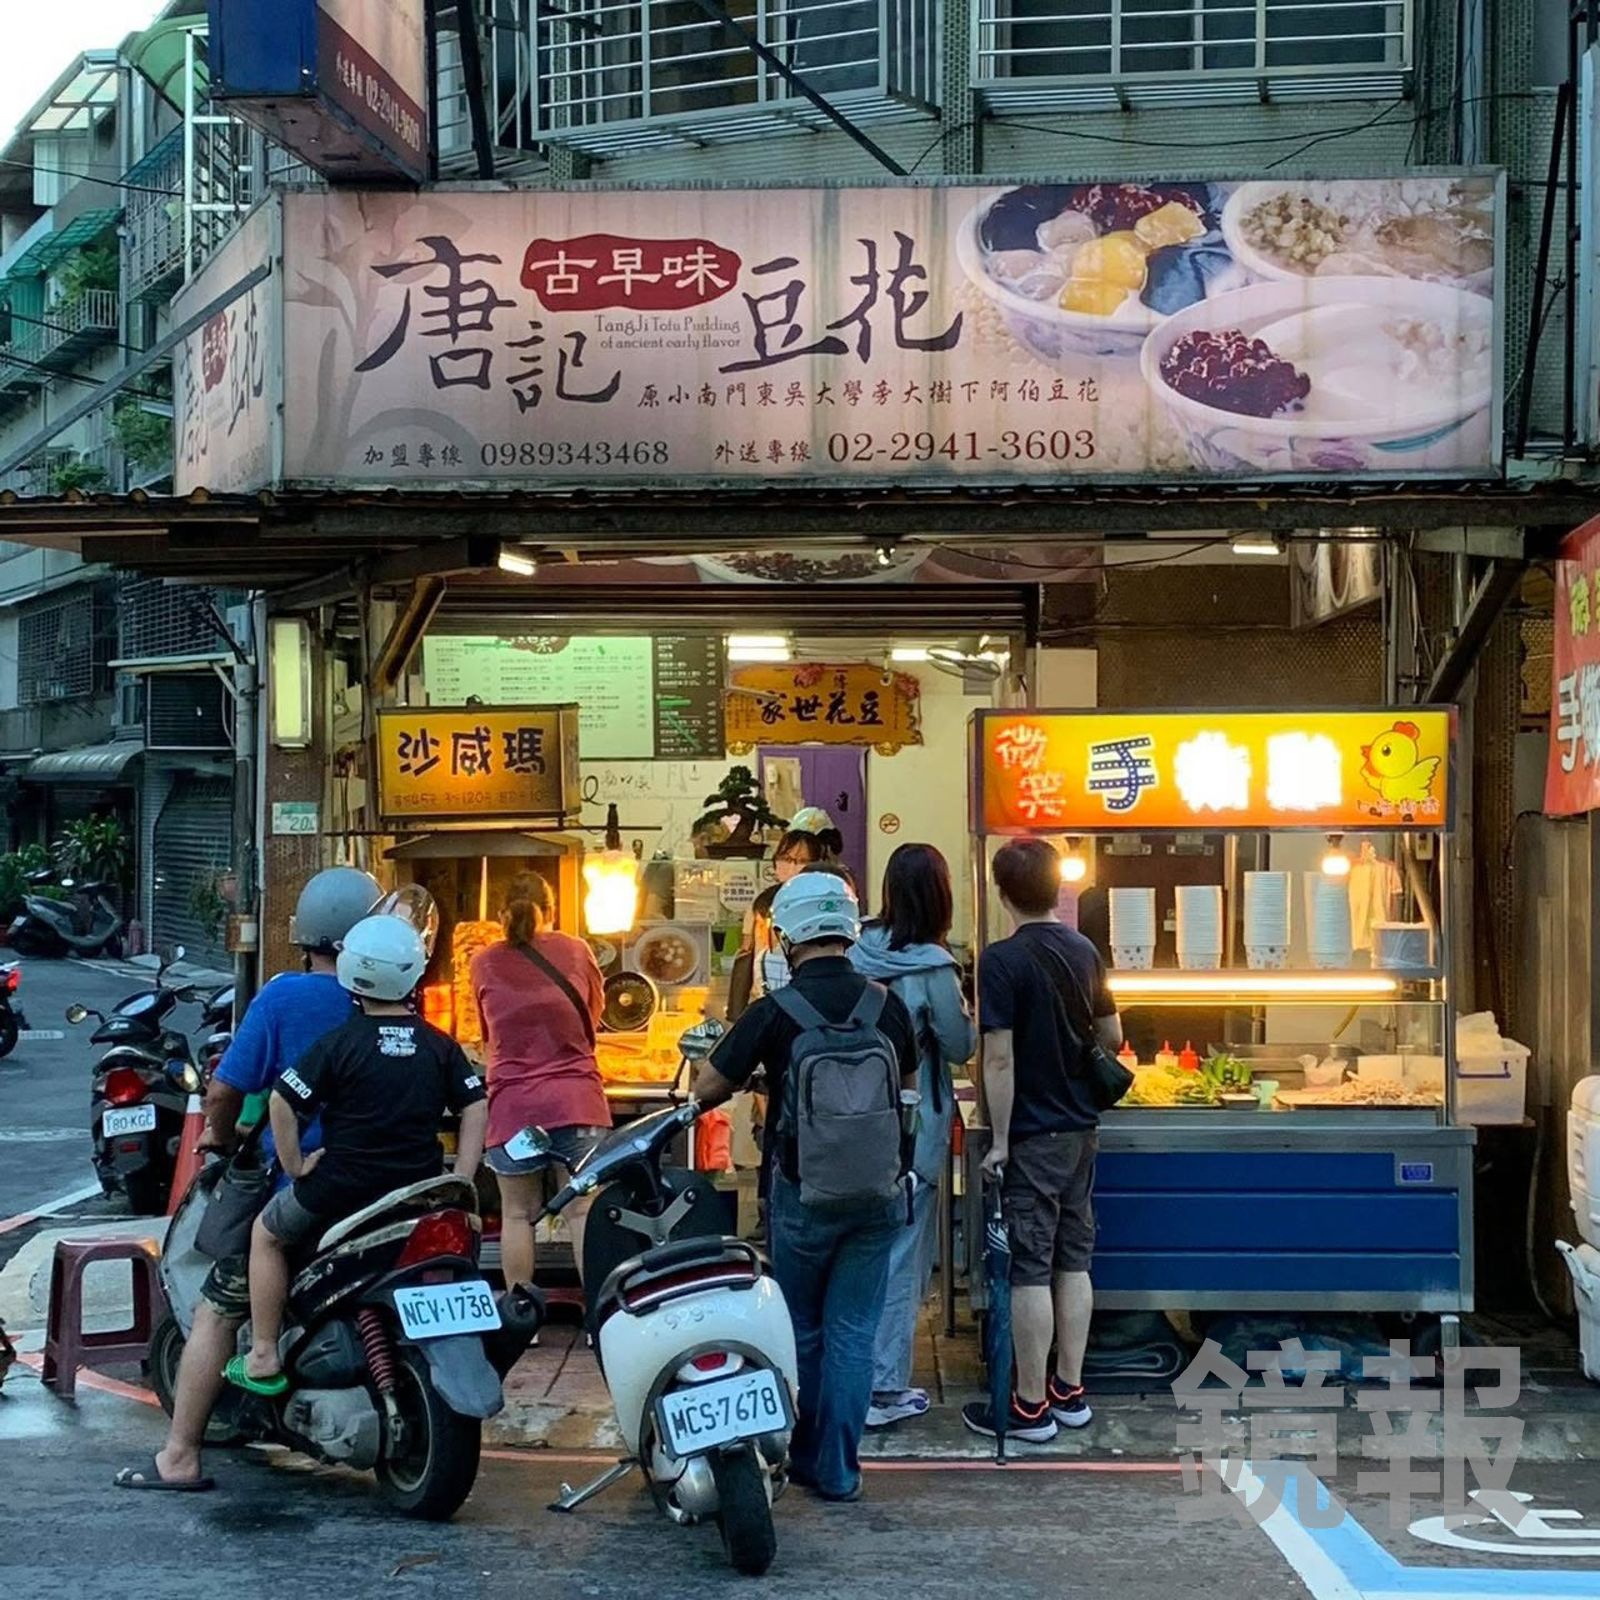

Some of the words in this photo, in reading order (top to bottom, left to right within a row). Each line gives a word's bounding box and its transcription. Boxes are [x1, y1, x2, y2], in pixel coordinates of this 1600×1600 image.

[530, 246, 729, 296] 古早味
[718, 231, 964, 374] 豆花
[652, 316, 681, 332] Tofu
[684, 316, 740, 333] Pudding
[600, 335, 614, 349] of
[615, 337, 664, 349] ancient
[666, 334, 700, 350] early
[702, 335, 740, 348] flavor
[637, 377, 1099, 408] 原小南門東吳大學旁大樹下阿伯豆花
[363, 445, 463, 468] 加盟專線
[480, 440, 669, 466] 0989343468
[714, 439, 813, 464] 外送專線
[828, 429, 1096, 462] 02-2941-3603
[397, 727, 546, 777] 沙威瑪
